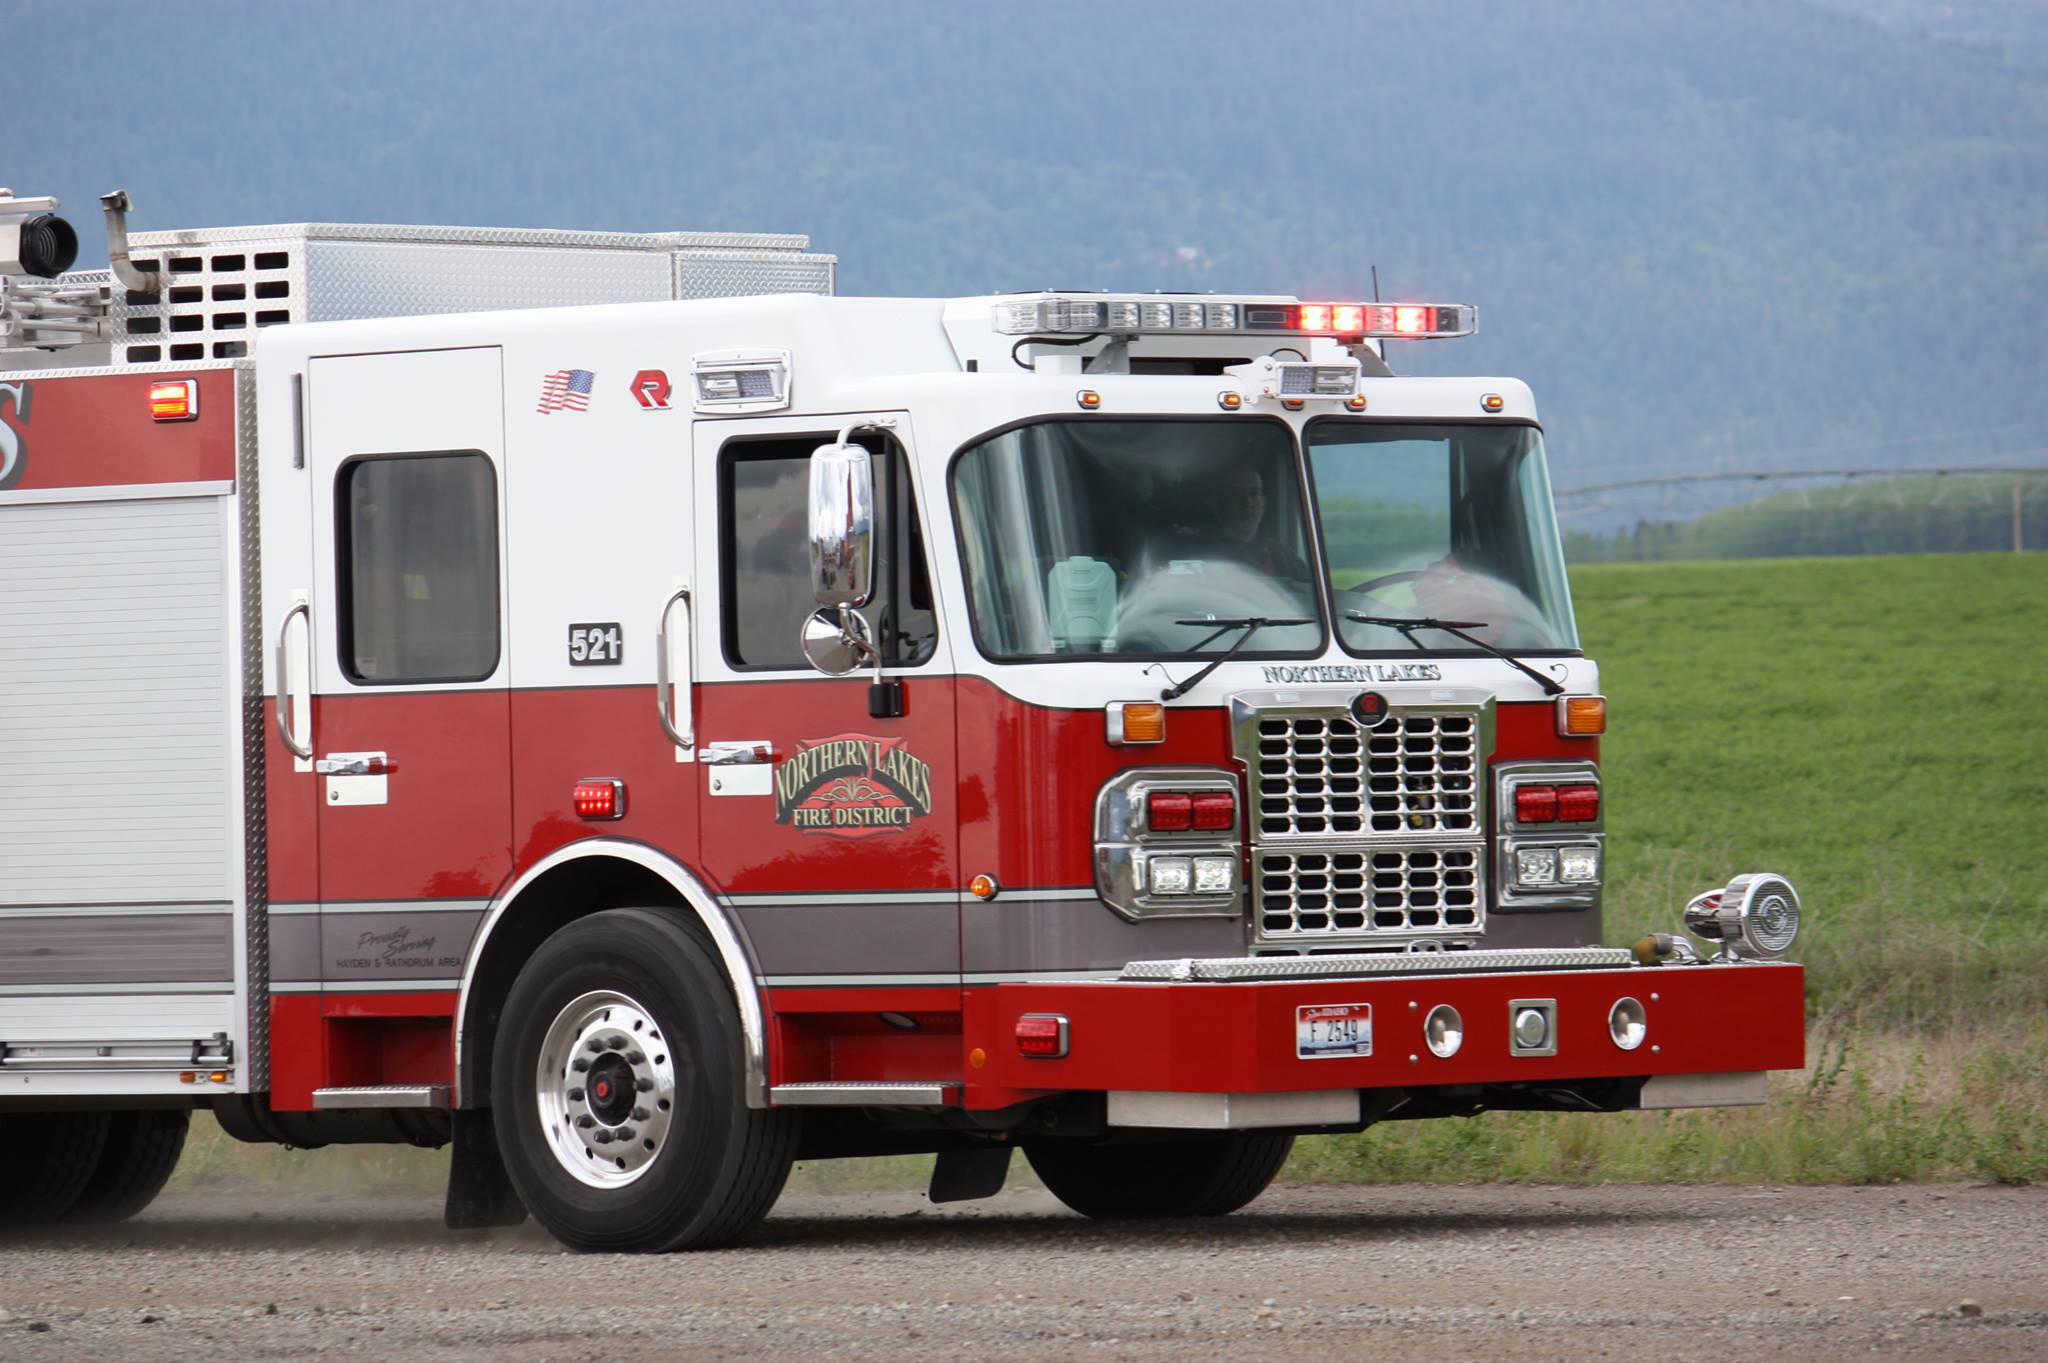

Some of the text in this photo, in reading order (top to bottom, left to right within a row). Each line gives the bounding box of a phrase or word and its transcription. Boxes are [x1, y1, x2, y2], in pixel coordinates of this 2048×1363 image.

[570, 627, 619, 662] 521
[1261, 663, 1442, 684] NORTHERN LAKES
[775, 740, 932, 822] NORTHERN LAKES
[793, 805, 913, 827] FIRE DISTRICT
[357, 926, 410, 949] Proudly
[382, 936, 436, 959] Serving
[336, 957, 461, 968] HAYDEN & RATHDRUM AREA
[1311, 1019, 1358, 1043] F 2549
